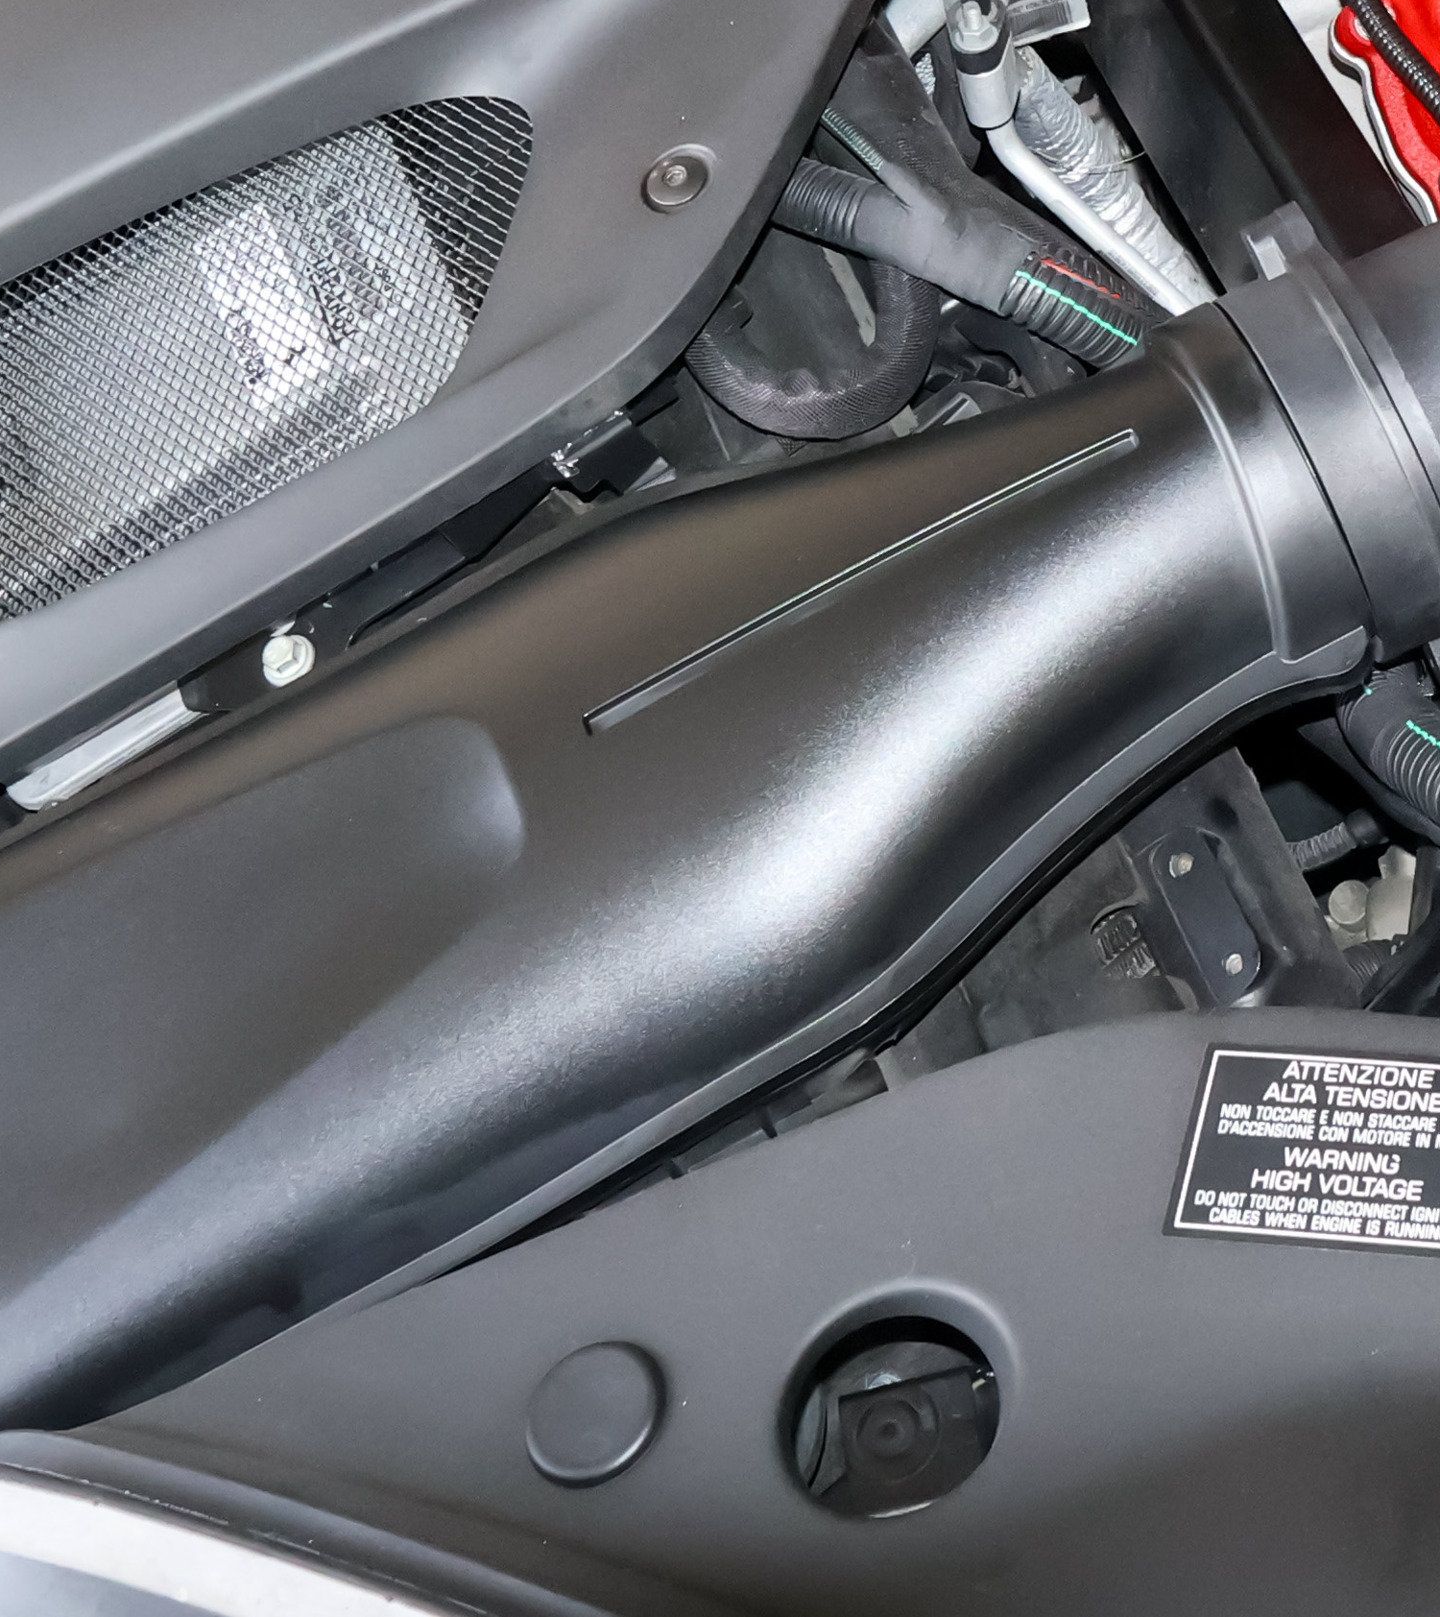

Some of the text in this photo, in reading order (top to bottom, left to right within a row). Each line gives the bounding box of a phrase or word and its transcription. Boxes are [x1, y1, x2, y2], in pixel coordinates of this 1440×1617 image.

[1282, 1061, 1435, 1088] ATTENZIONE
[1263, 1082, 1317, 1104] ALTA
[1220, 1103, 1252, 1119] NON
[1256, 1105, 1316, 1124] TOCCARE
[1319, 1109, 1329, 1125] E
[1332, 1110, 1364, 1127] NON
[1367, 1113, 1437, 1132] STACCARE
[1217, 1119, 1315, 1140] D'ACCENSIONE
[1318, 1125, 1349, 1142] CON
[1352, 1127, 1412, 1147] MOTORE
[1415, 1132, 1431, 1148] IN
[1284, 1146, 1401, 1175] WARNING
[1251, 1168, 1424, 1201] HIGH VOLTAGE
[1194, 1189, 1216, 1206] DO
[1217, 1191, 1248, 1208] NOT
[1249, 1193, 1296, 1212] TOUCH
[1297, 1197, 1319, 1213] OR
[1320, 1199, 1409, 1221] DISCONNECT
[1208, 1207, 1260, 1226] CABLES
[1264, 1211, 1308, 1230] WHEN
[1310, 1214, 1362, 1234] ENGINE
[1365, 1219, 1380, 1236] IS
